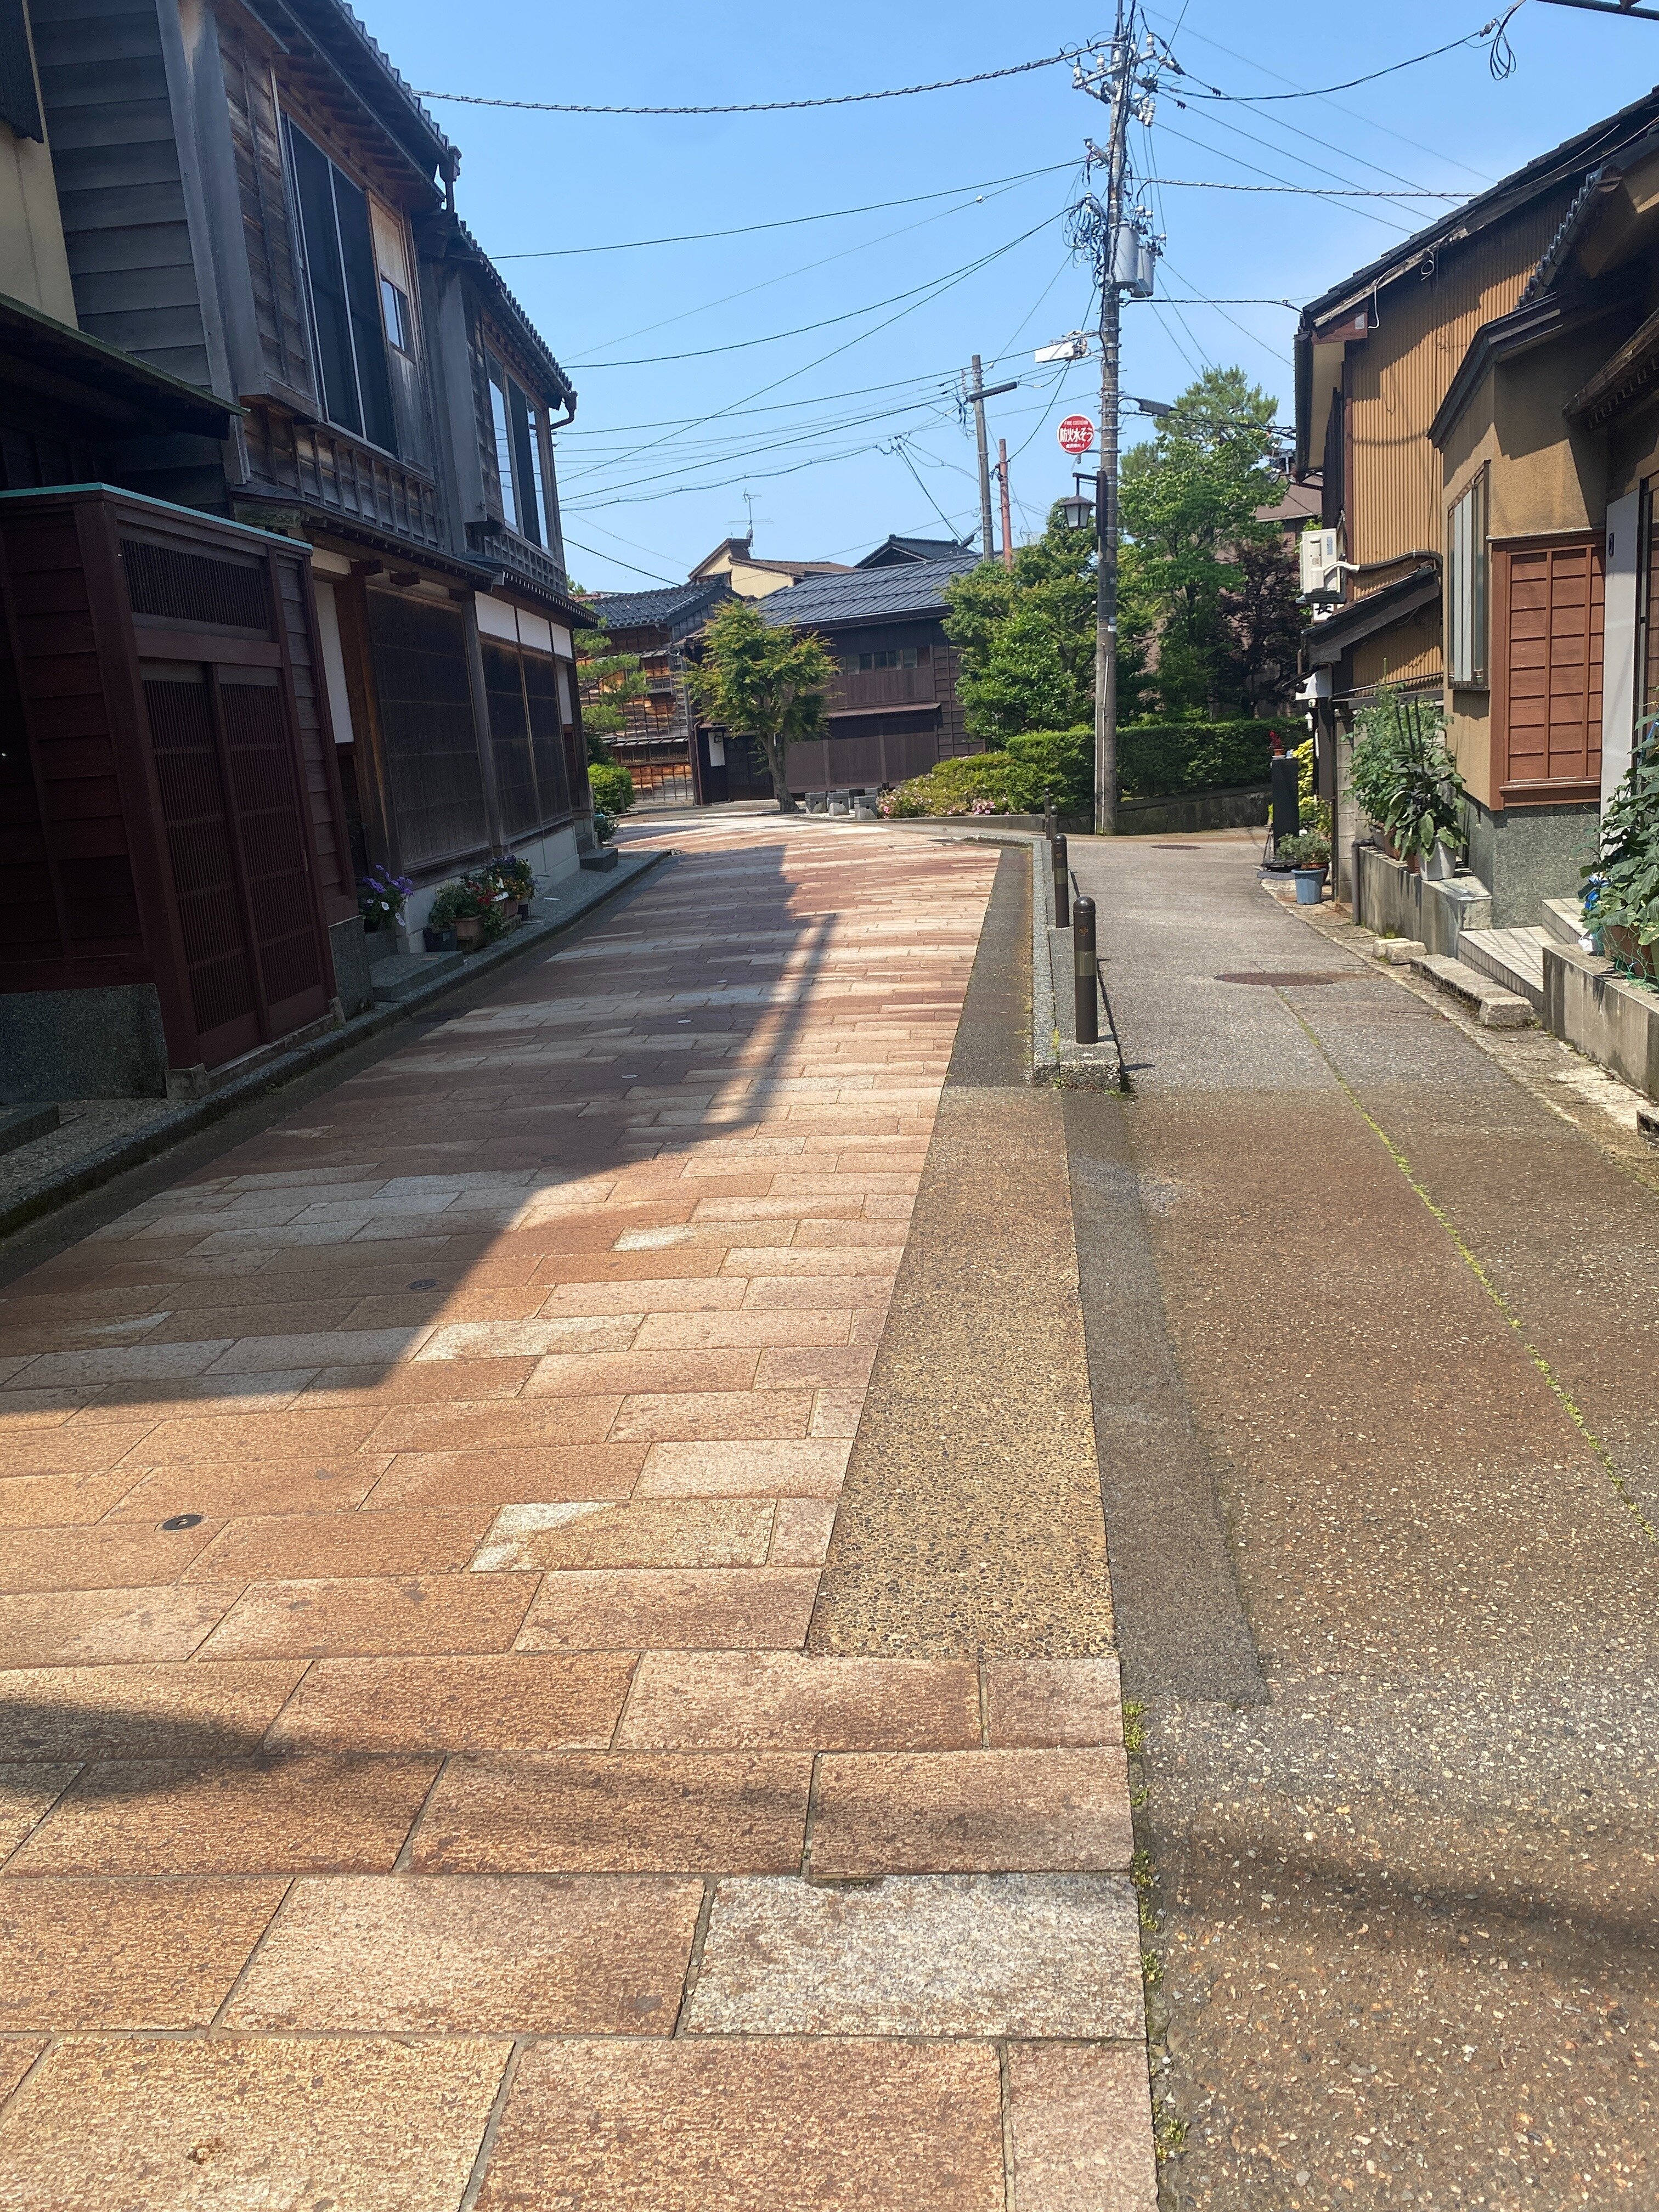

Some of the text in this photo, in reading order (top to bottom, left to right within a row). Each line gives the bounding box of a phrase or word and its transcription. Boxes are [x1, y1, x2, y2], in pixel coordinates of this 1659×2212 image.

[1060, 427, 1093, 443] 防火水そう
